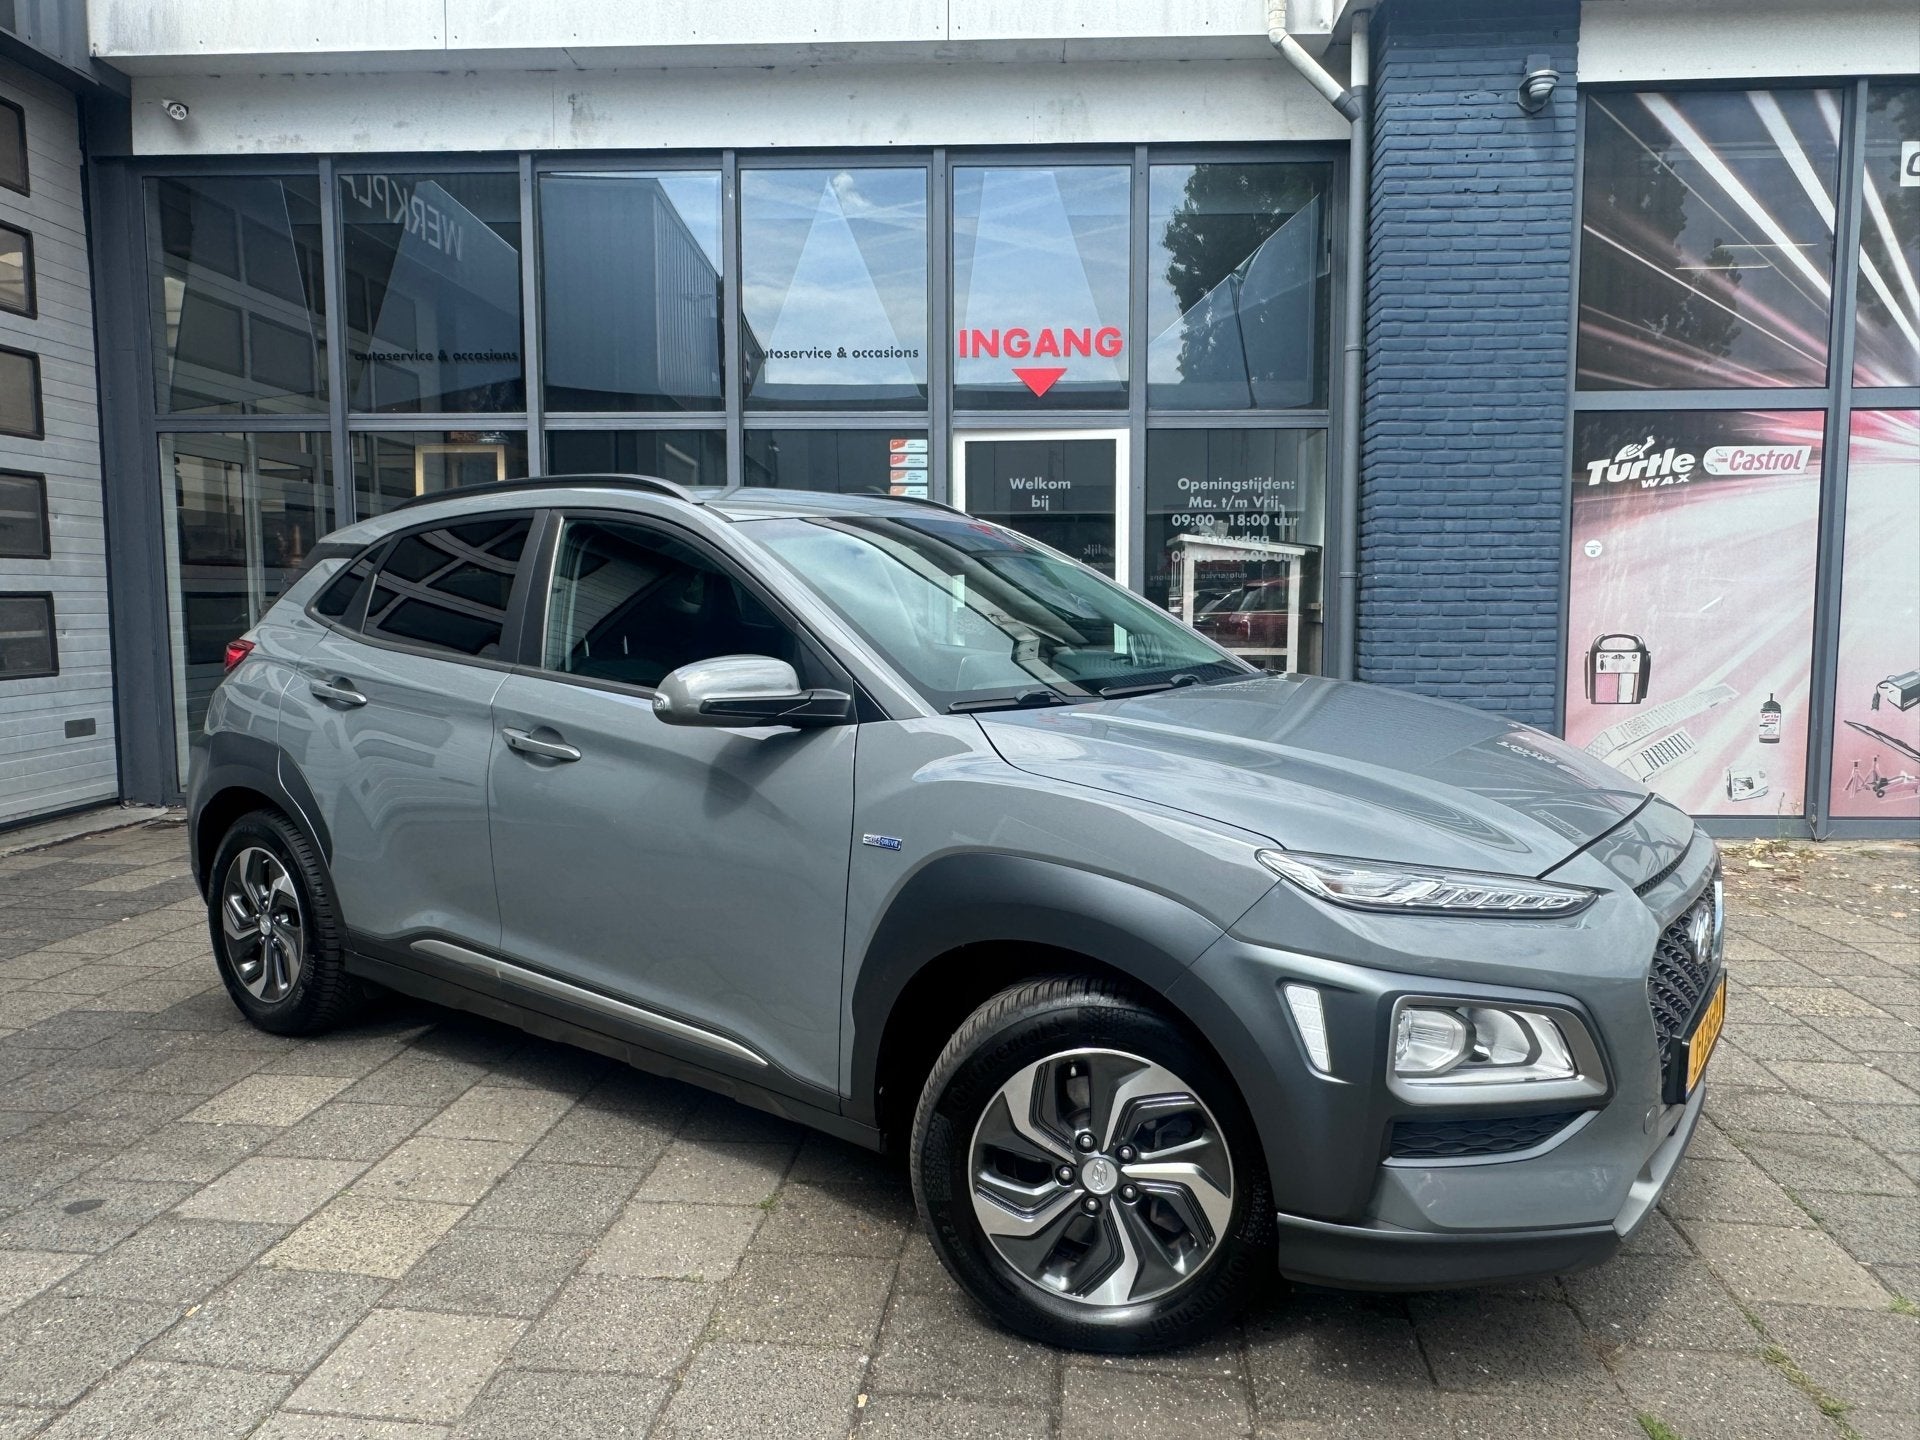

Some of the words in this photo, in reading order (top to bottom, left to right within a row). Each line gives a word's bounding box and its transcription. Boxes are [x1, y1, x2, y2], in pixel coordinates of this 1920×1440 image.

[959, 326, 1123, 358] INGANG
[355, 350, 434, 362] autoservice
[438, 350, 449, 362] &
[453, 348, 519, 362] occasions
[836, 346, 848, 358] &
[851, 345, 919, 358] occasions
[1586, 447, 1696, 486] Turtle
[1729, 449, 1803, 471] Castrol
[1009, 477, 1071, 490] Welkom
[1177, 477, 1296, 493] Openingstijden:
[1641, 473, 1691, 489] WAX
[1031, 495, 1049, 511] bij
[1188, 496, 1217, 508] Ma.
[1221, 495, 1248, 510] t/m
[1171, 514, 1215, 527] 09:00
[1229, 514, 1270, 527] 18:00
[1274, 516, 1299, 527] uur
